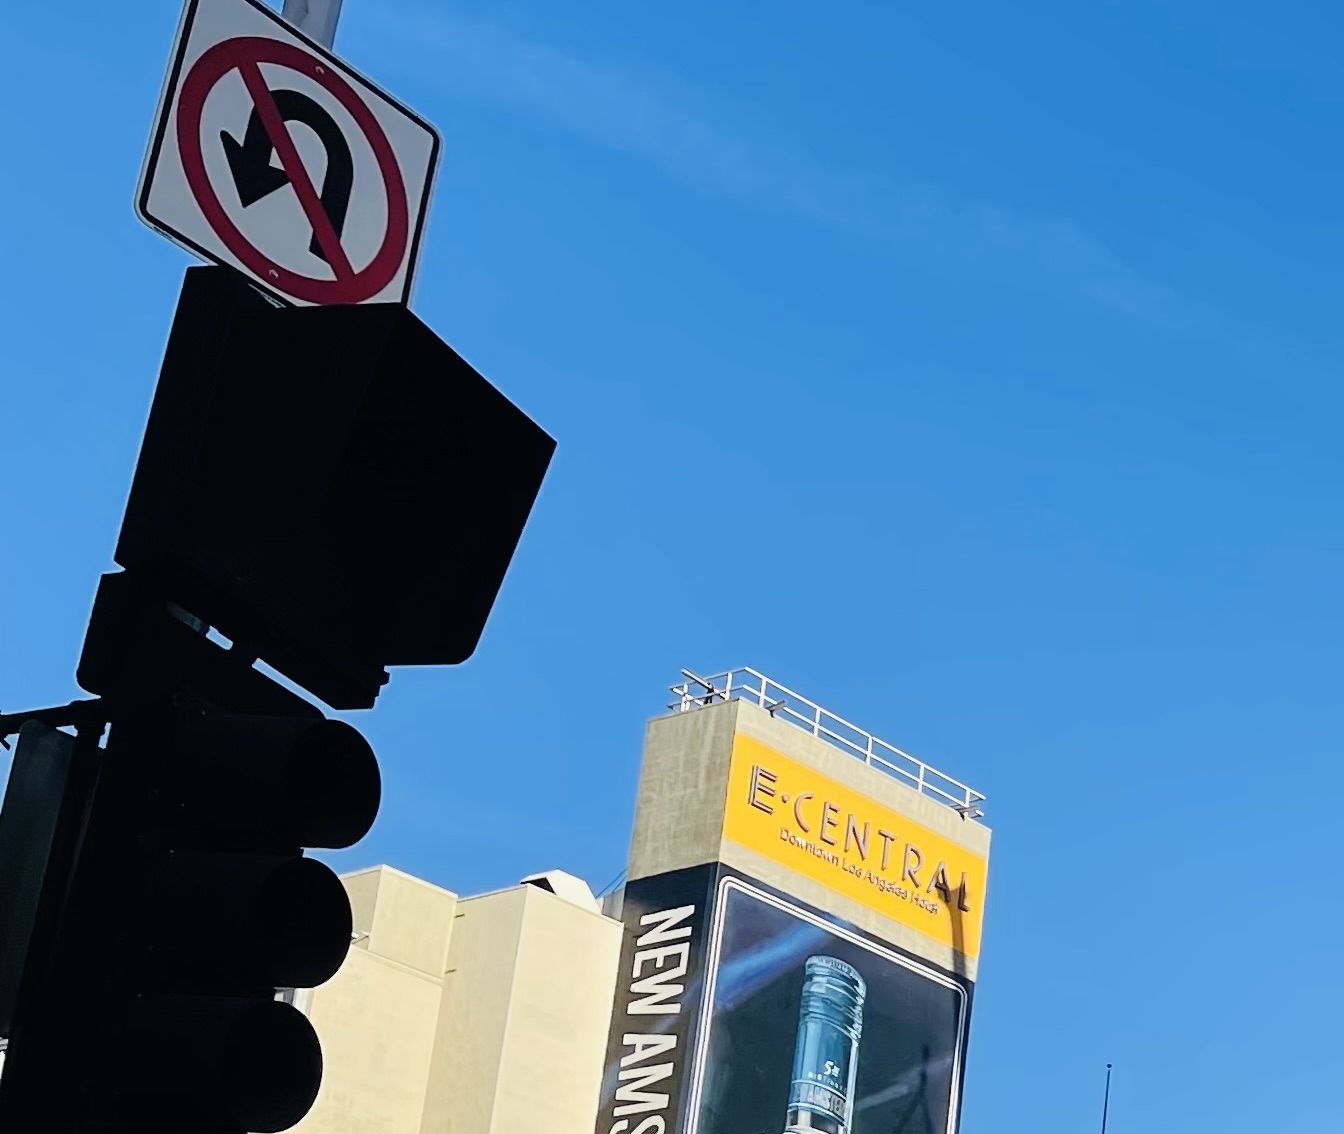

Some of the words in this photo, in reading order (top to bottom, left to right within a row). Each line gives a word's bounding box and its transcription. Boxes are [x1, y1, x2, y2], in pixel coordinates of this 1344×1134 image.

[780, 827, 839, 868] Downtown
[842, 857, 863, 878] Los
[864, 869, 908, 900] Angeles
[910, 889, 939, 916] Hotel
[626, 904, 696, 1015] NEW
